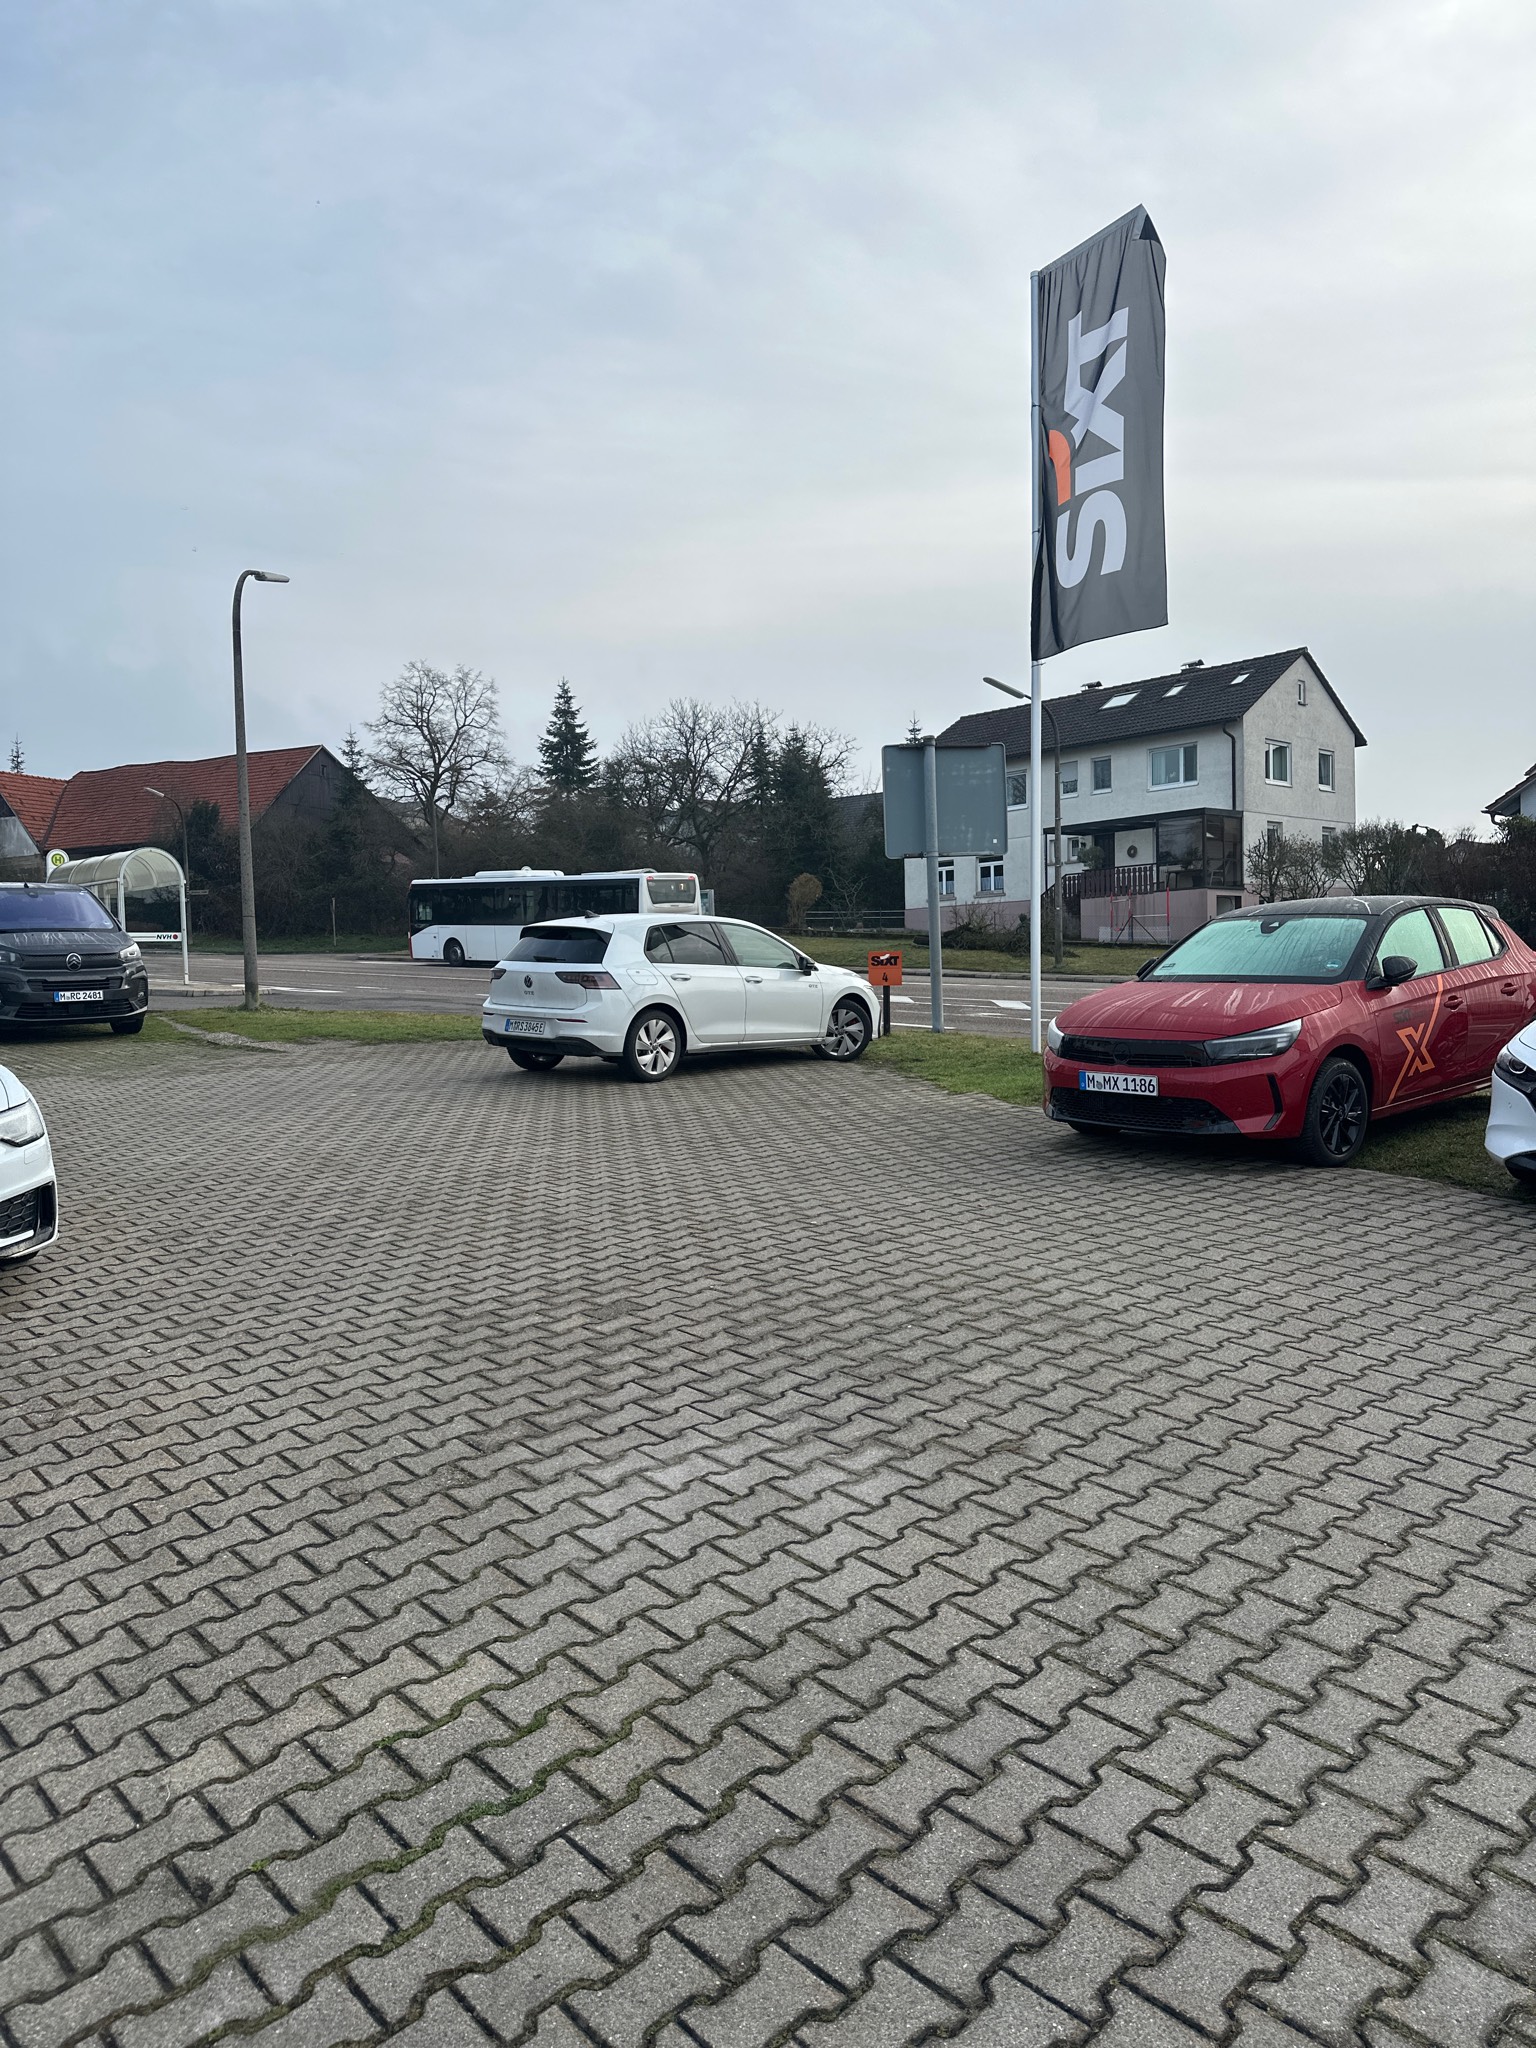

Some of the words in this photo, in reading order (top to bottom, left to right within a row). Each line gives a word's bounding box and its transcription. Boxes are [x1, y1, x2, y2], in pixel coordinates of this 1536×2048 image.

[1050, 307, 1128, 588] SIXT
[871, 954, 899, 966] SIXT
[882, 972, 888, 982] 4
[60, 992, 66, 1000] M
[71, 992, 81, 1000] RC
[82, 991, 102, 1000] 2481
[1087, 1074, 1096, 1089] M
[1103, 1075, 1120, 1091] MX
